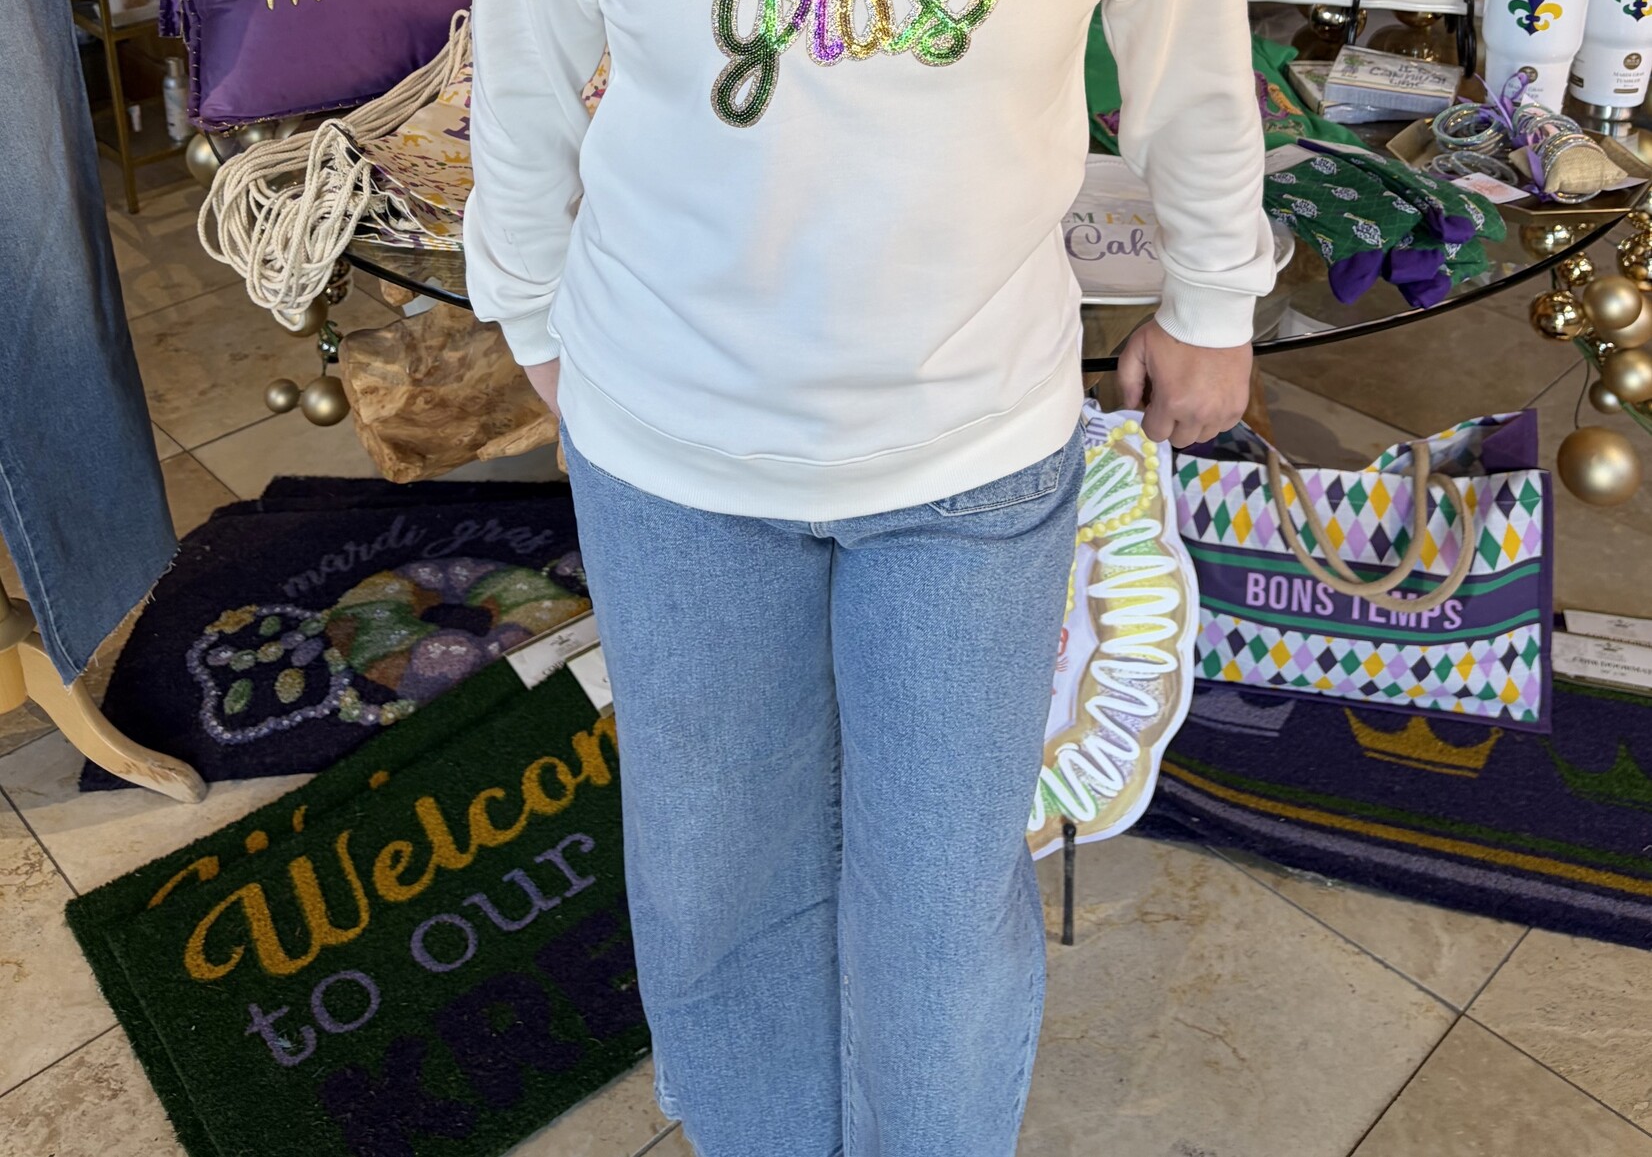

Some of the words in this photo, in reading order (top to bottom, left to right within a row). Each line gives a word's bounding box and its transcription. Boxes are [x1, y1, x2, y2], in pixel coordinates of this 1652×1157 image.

[1064, 224, 1159, 261] Cak
[281, 515, 428, 599] mardi
[421, 518, 556, 559] gras
[1246, 572, 1335, 616] BONS
[243, 969, 382, 1068] to
[410, 832, 598, 973] our
